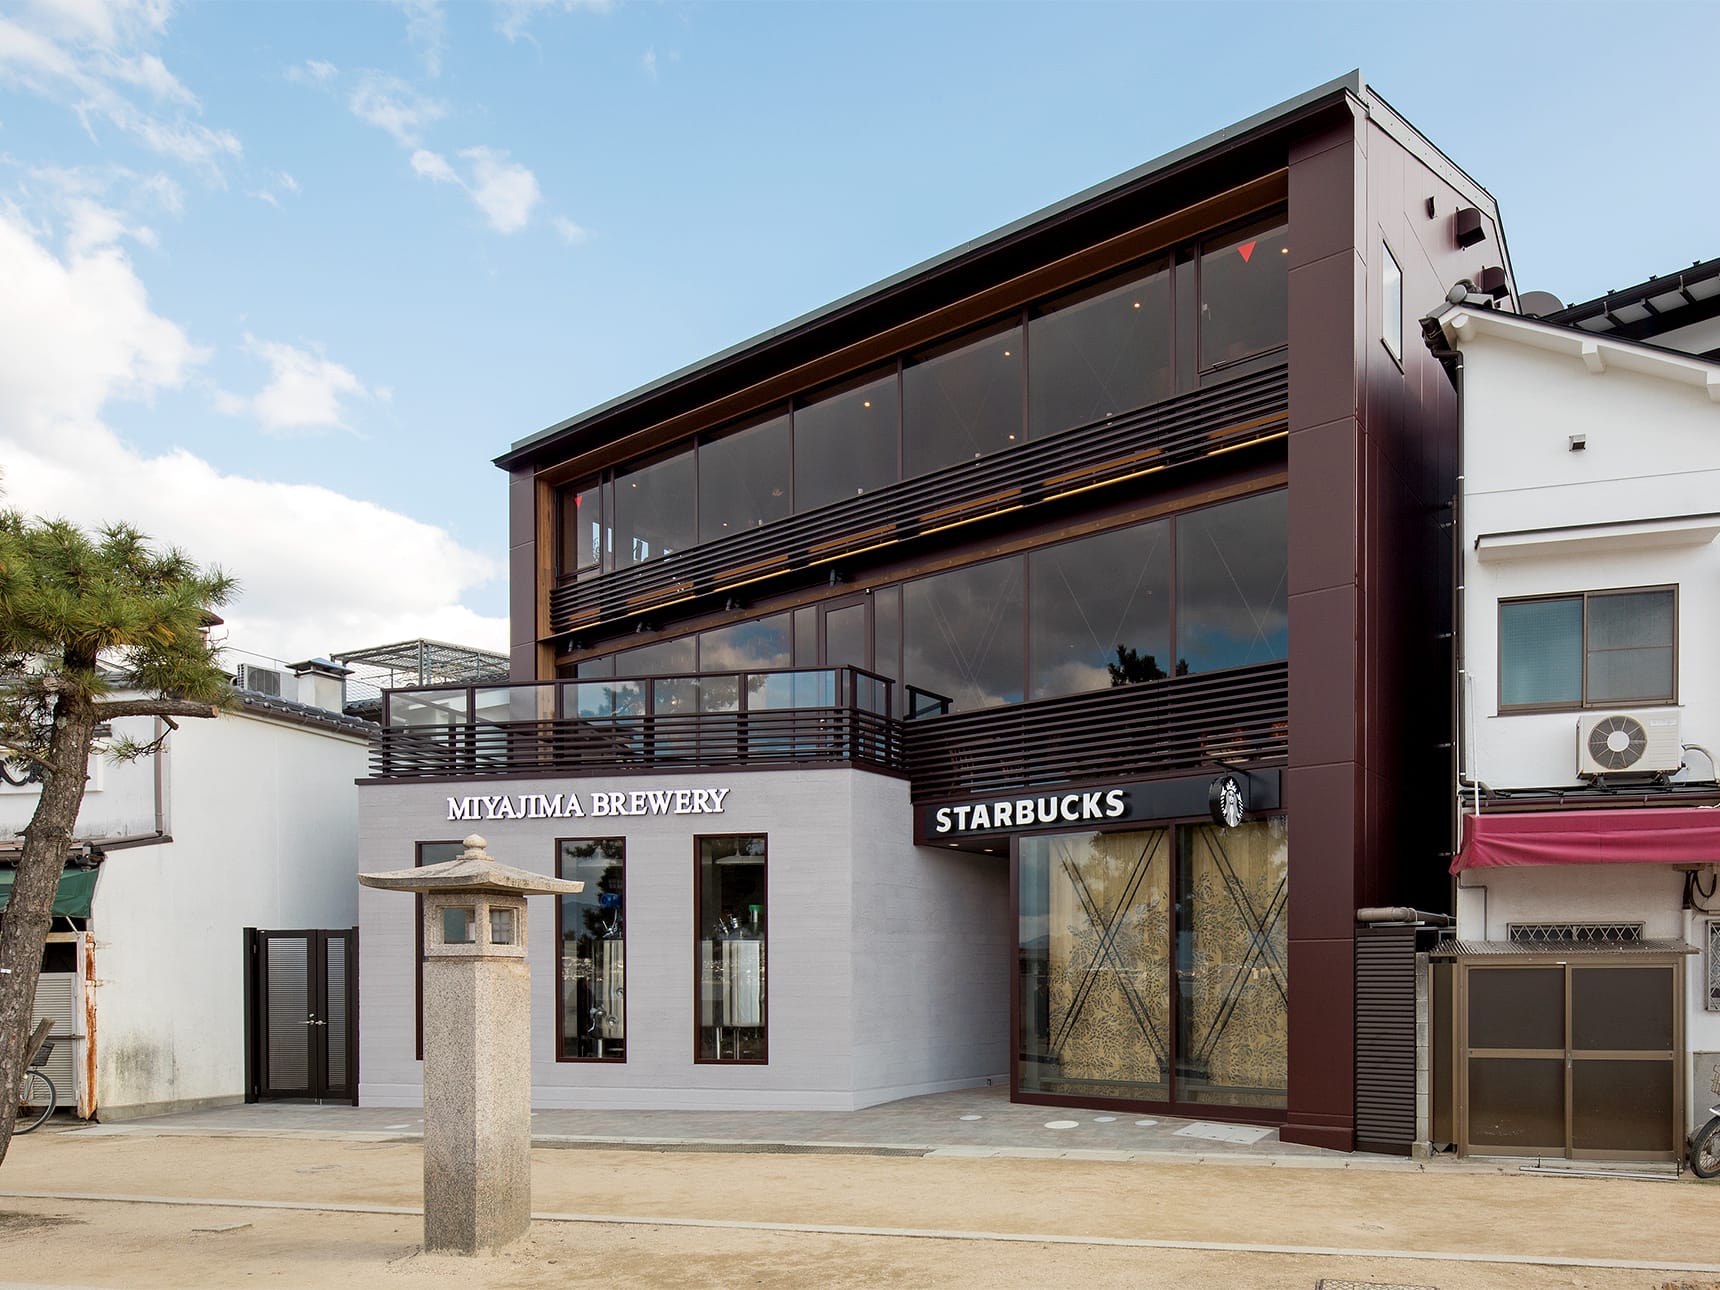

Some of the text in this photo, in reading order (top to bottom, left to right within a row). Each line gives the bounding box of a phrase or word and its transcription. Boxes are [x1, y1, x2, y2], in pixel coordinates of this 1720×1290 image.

[446, 788, 730, 820] MIYAJIMA BREWERY
[936, 789, 1126, 833] STARBUCKS
